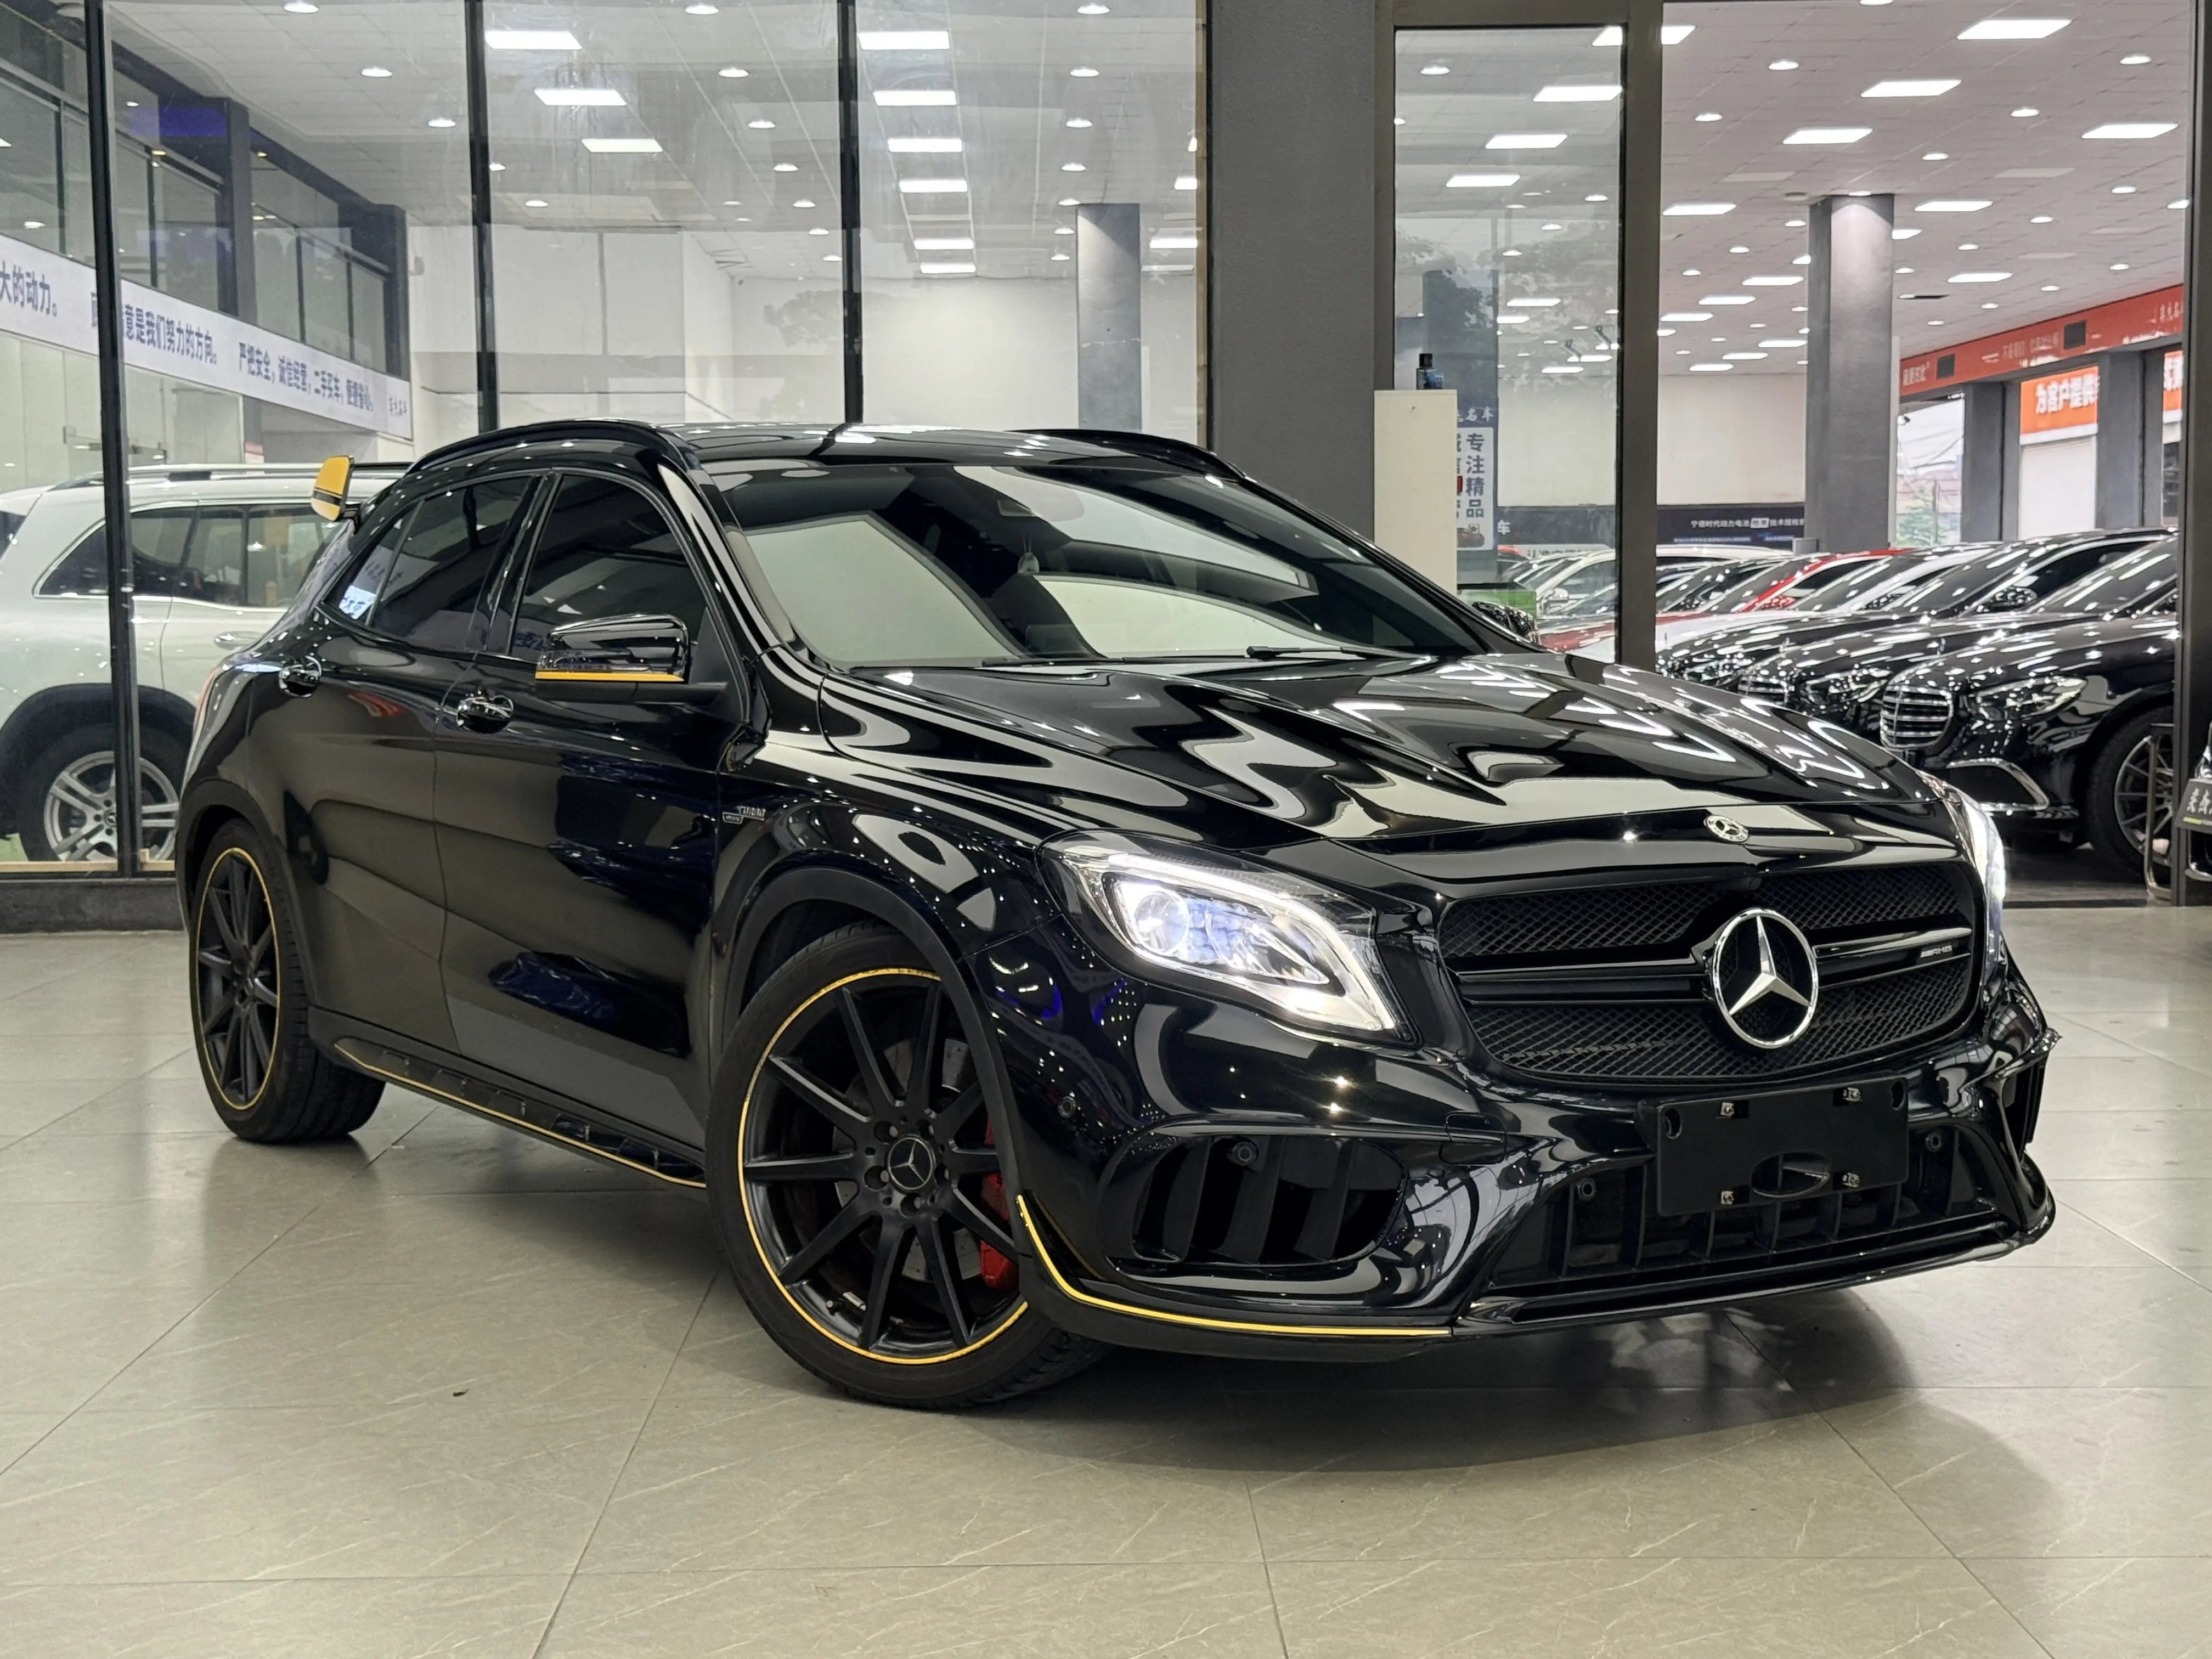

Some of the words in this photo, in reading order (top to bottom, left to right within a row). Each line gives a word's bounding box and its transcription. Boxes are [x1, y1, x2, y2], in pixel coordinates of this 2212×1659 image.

[123, 303, 217, 365] 意是我们努力的方向。
[1465, 433, 1485, 518] 专注精品
